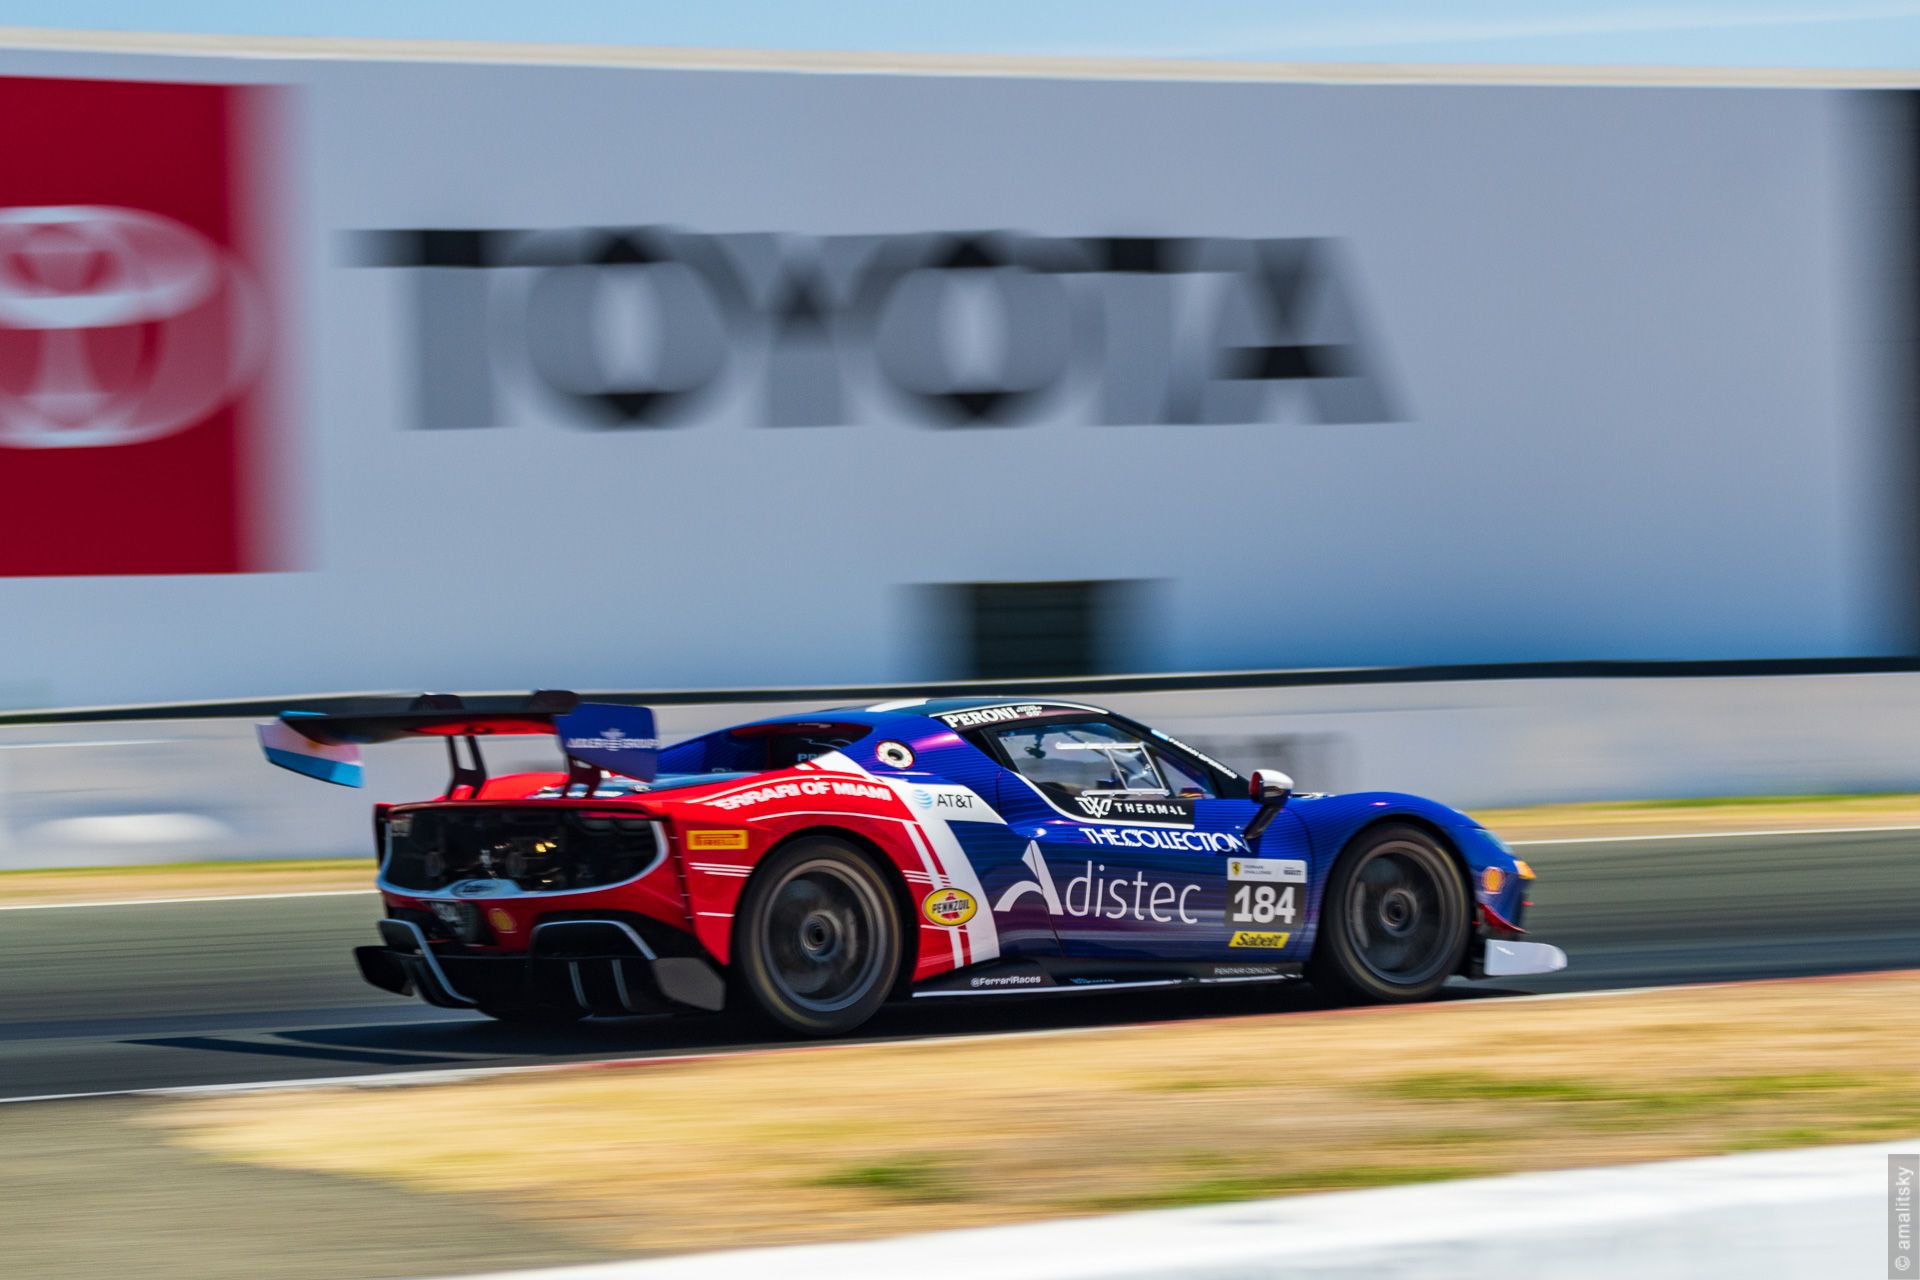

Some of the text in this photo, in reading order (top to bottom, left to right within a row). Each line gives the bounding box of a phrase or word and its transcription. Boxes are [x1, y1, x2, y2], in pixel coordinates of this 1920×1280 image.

[338, 224, 1416, 431] TOYOTA
[942, 706, 1020, 728] PERONI
[801, 781, 830, 795] OF
[830, 782, 892, 802] MIAMI
[936, 793, 974, 809] AT&T
[1114, 802, 1187, 816] THERMAL
[932, 899, 970, 913] PENNZOIL
[1232, 885, 1297, 924] 184
[970, 975, 1042, 988] @FerrariRaces
